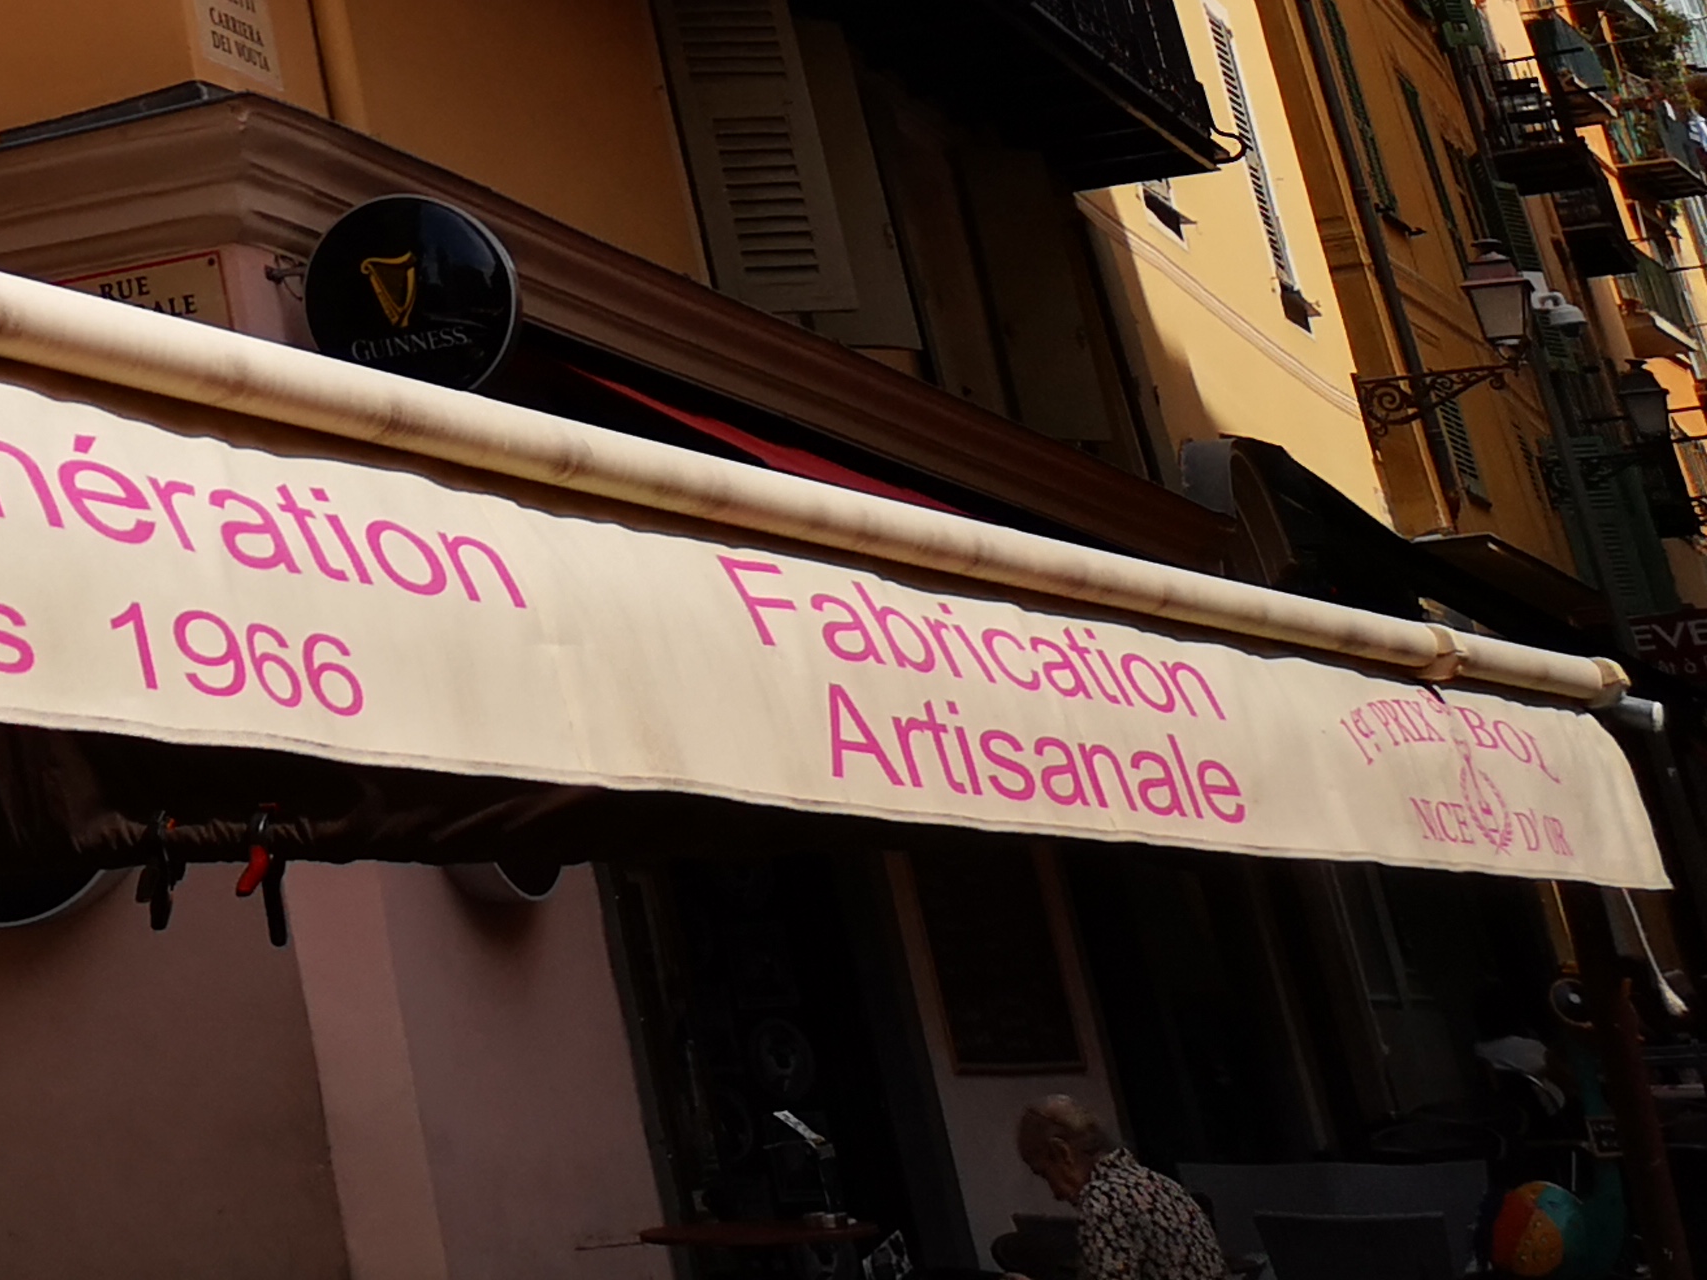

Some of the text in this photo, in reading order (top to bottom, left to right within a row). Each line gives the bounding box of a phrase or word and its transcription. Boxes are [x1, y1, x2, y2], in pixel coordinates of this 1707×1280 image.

[209, 6, 265, 48] CARRIERA
[211, 30, 233, 55] DEI
[99, 276, 150, 301] RUE
[351, 327, 469, 361] GUINNESS
[716, 555, 1227, 721] Fabrication
[109, 601, 365, 718] 1966
[828, 682, 1247, 825] Artisanale
